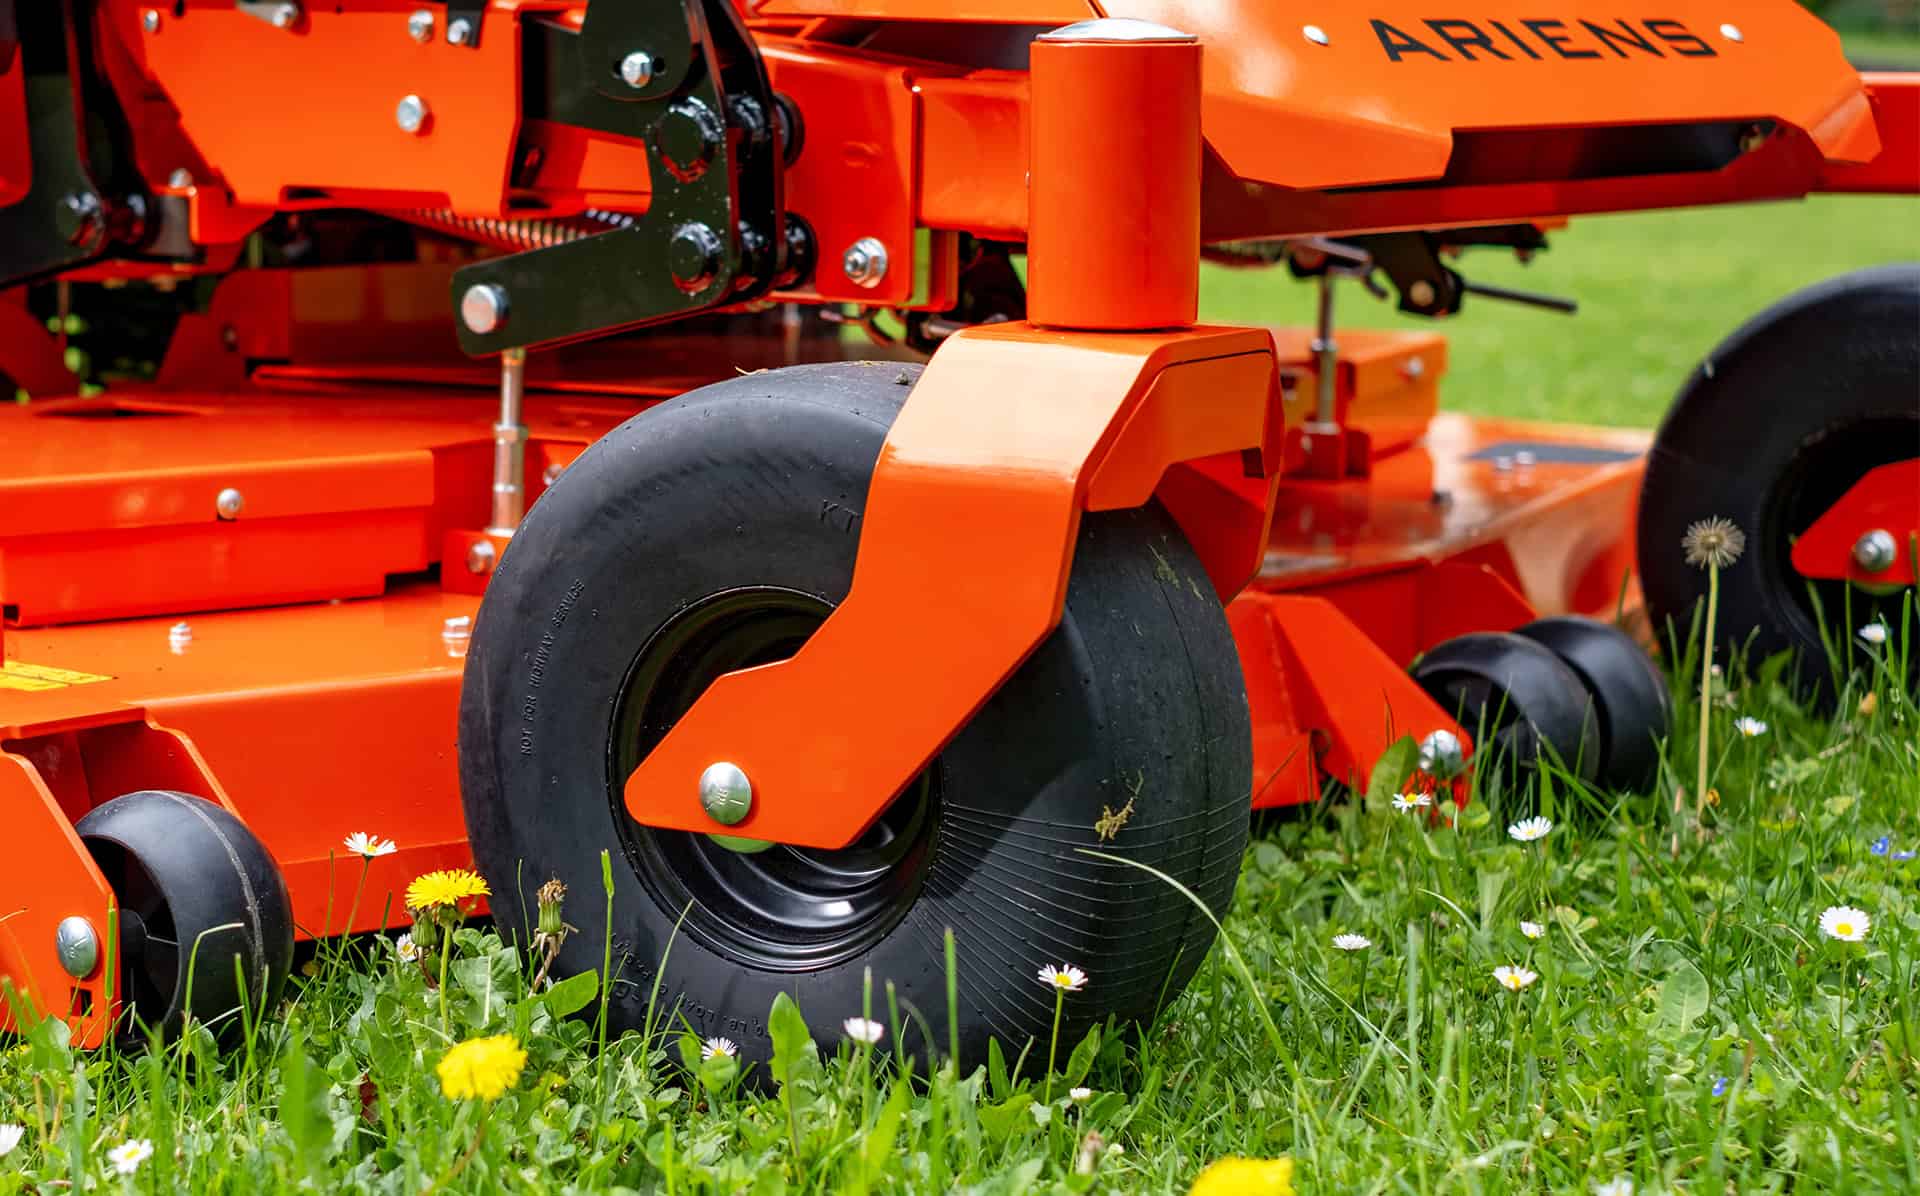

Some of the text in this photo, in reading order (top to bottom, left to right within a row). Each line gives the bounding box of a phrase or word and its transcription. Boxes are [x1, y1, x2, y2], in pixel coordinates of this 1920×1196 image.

[1369, 19, 1719, 62] ARIENS
[521, 578, 585, 756] NOT FOR HIGHWAY SERVICE
